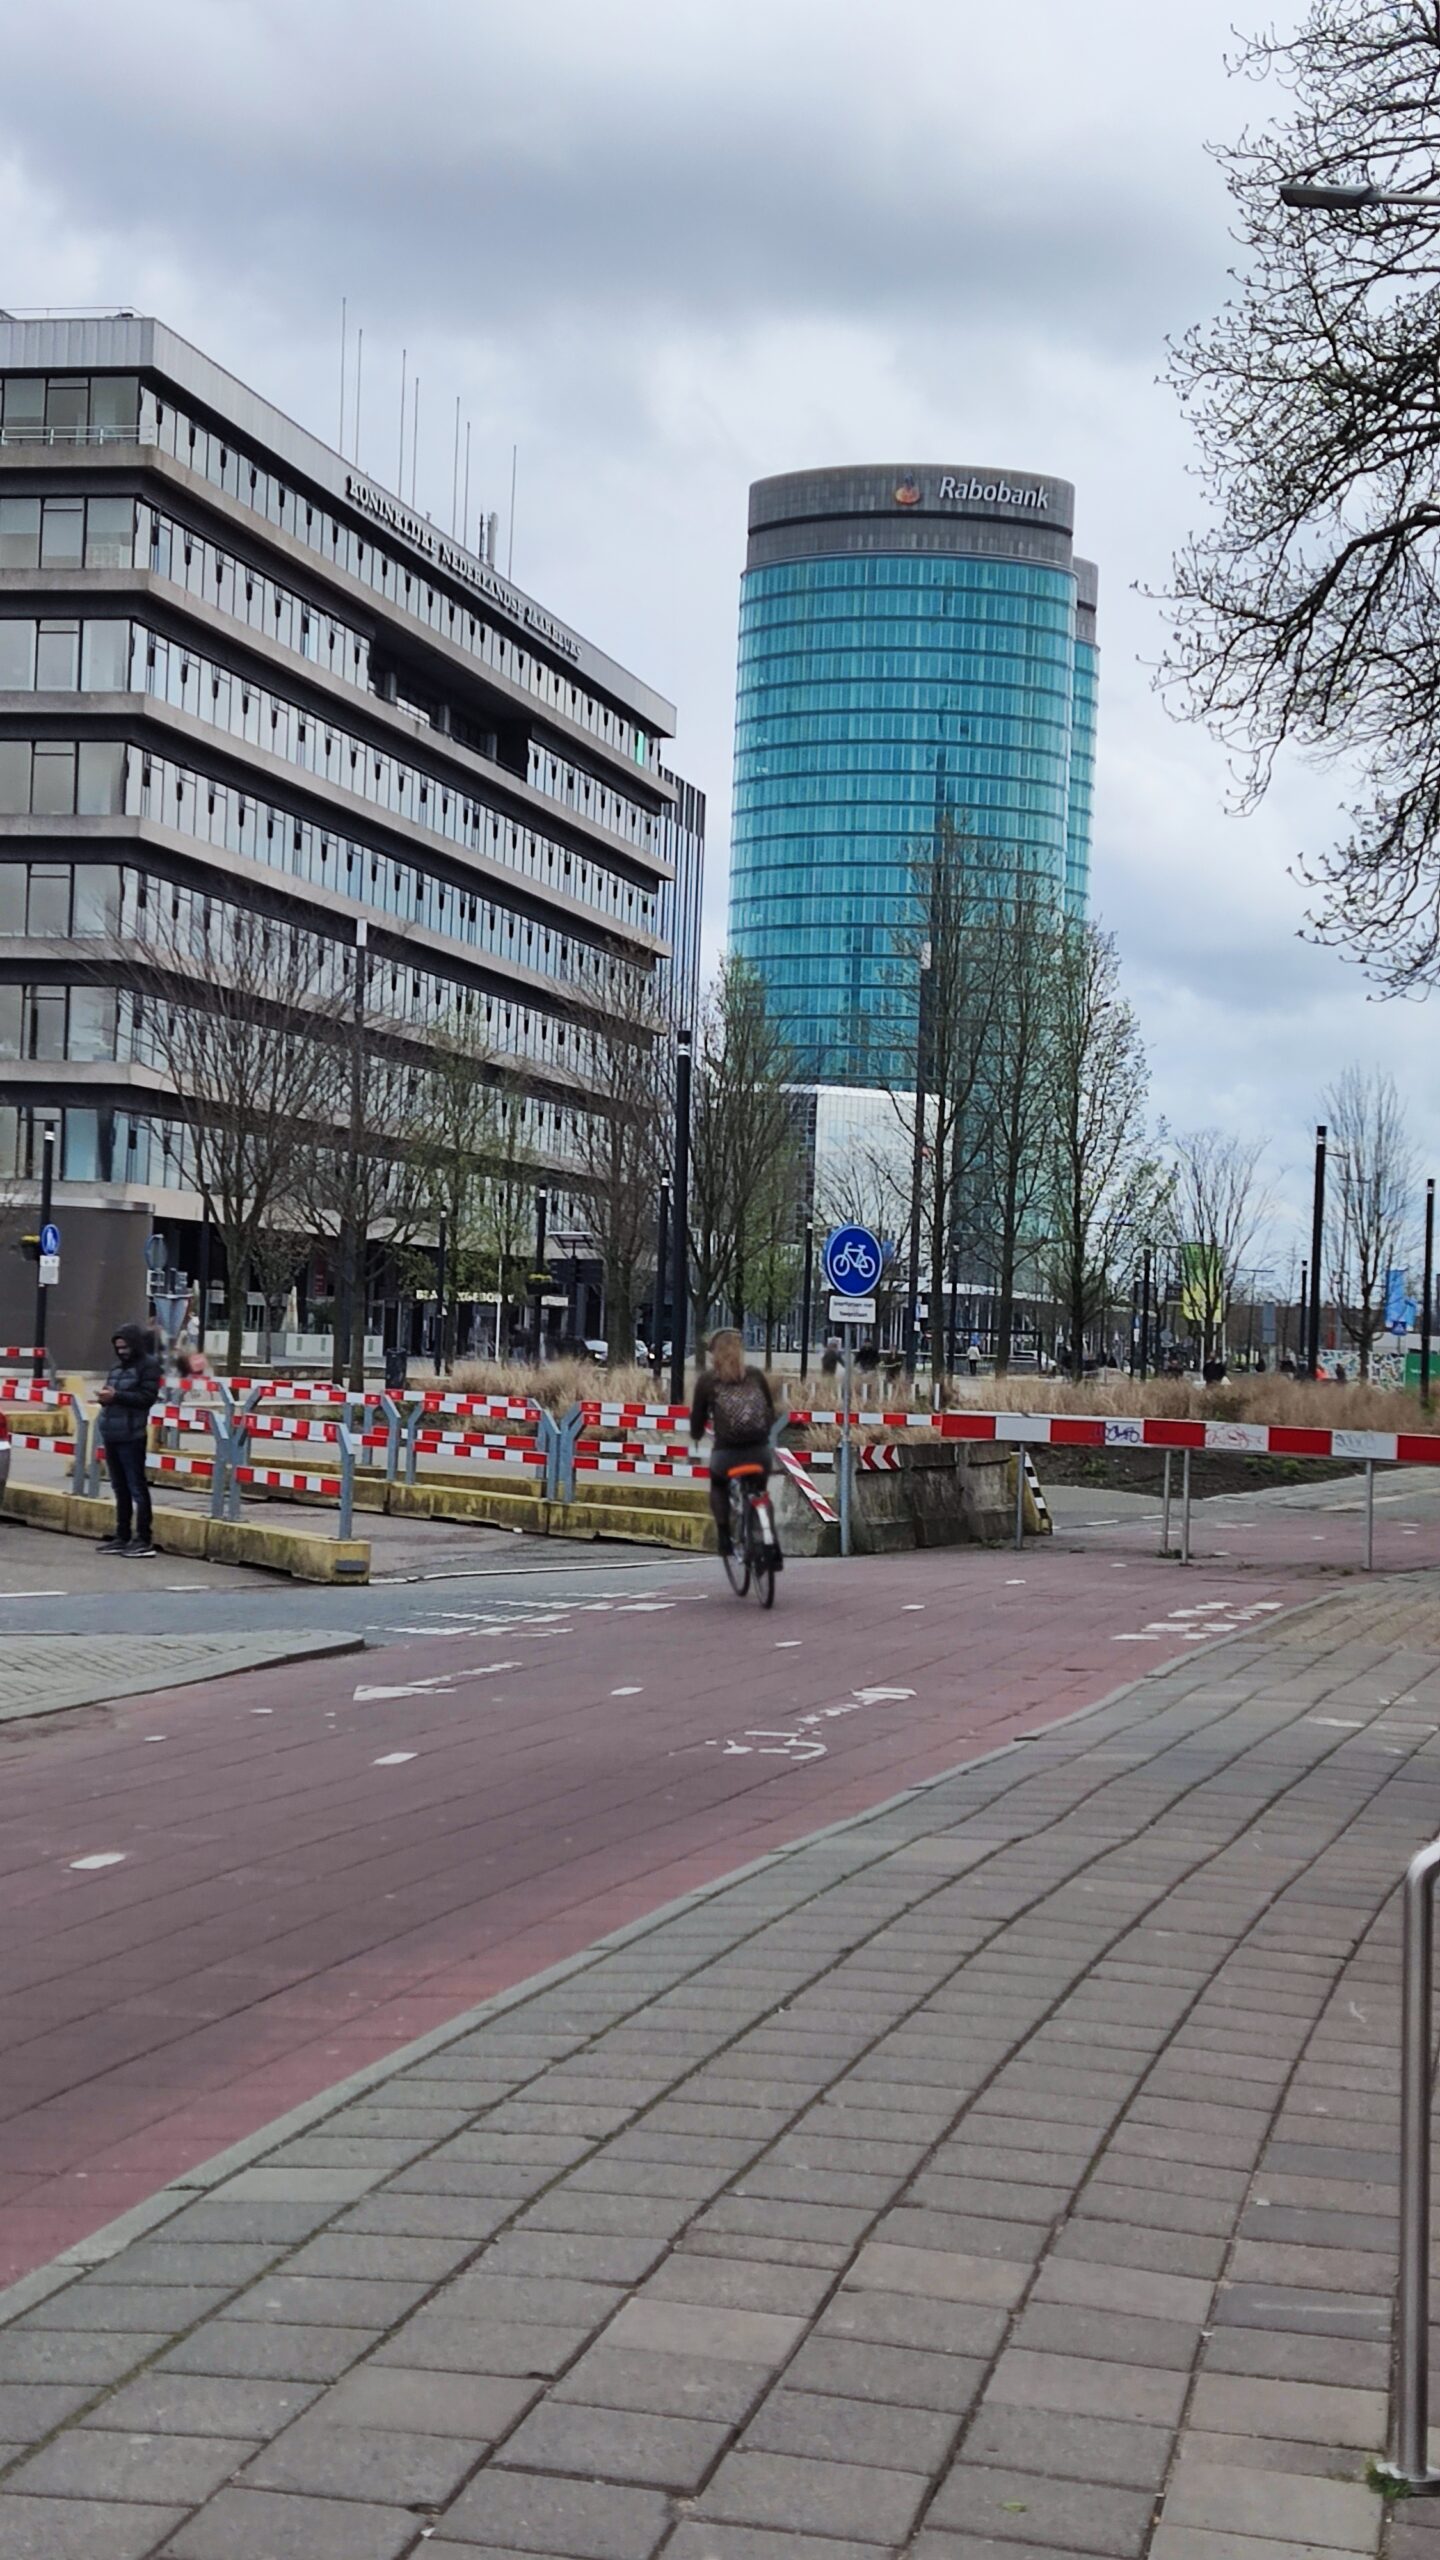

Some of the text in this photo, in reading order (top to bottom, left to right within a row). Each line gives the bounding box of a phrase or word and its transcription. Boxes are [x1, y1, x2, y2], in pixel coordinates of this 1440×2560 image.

[940, 476, 1049, 509] Rabobank
[347, 476, 436, 555] KONINKLIJKE
[440, 543, 523, 614] NEDERLANDSE
